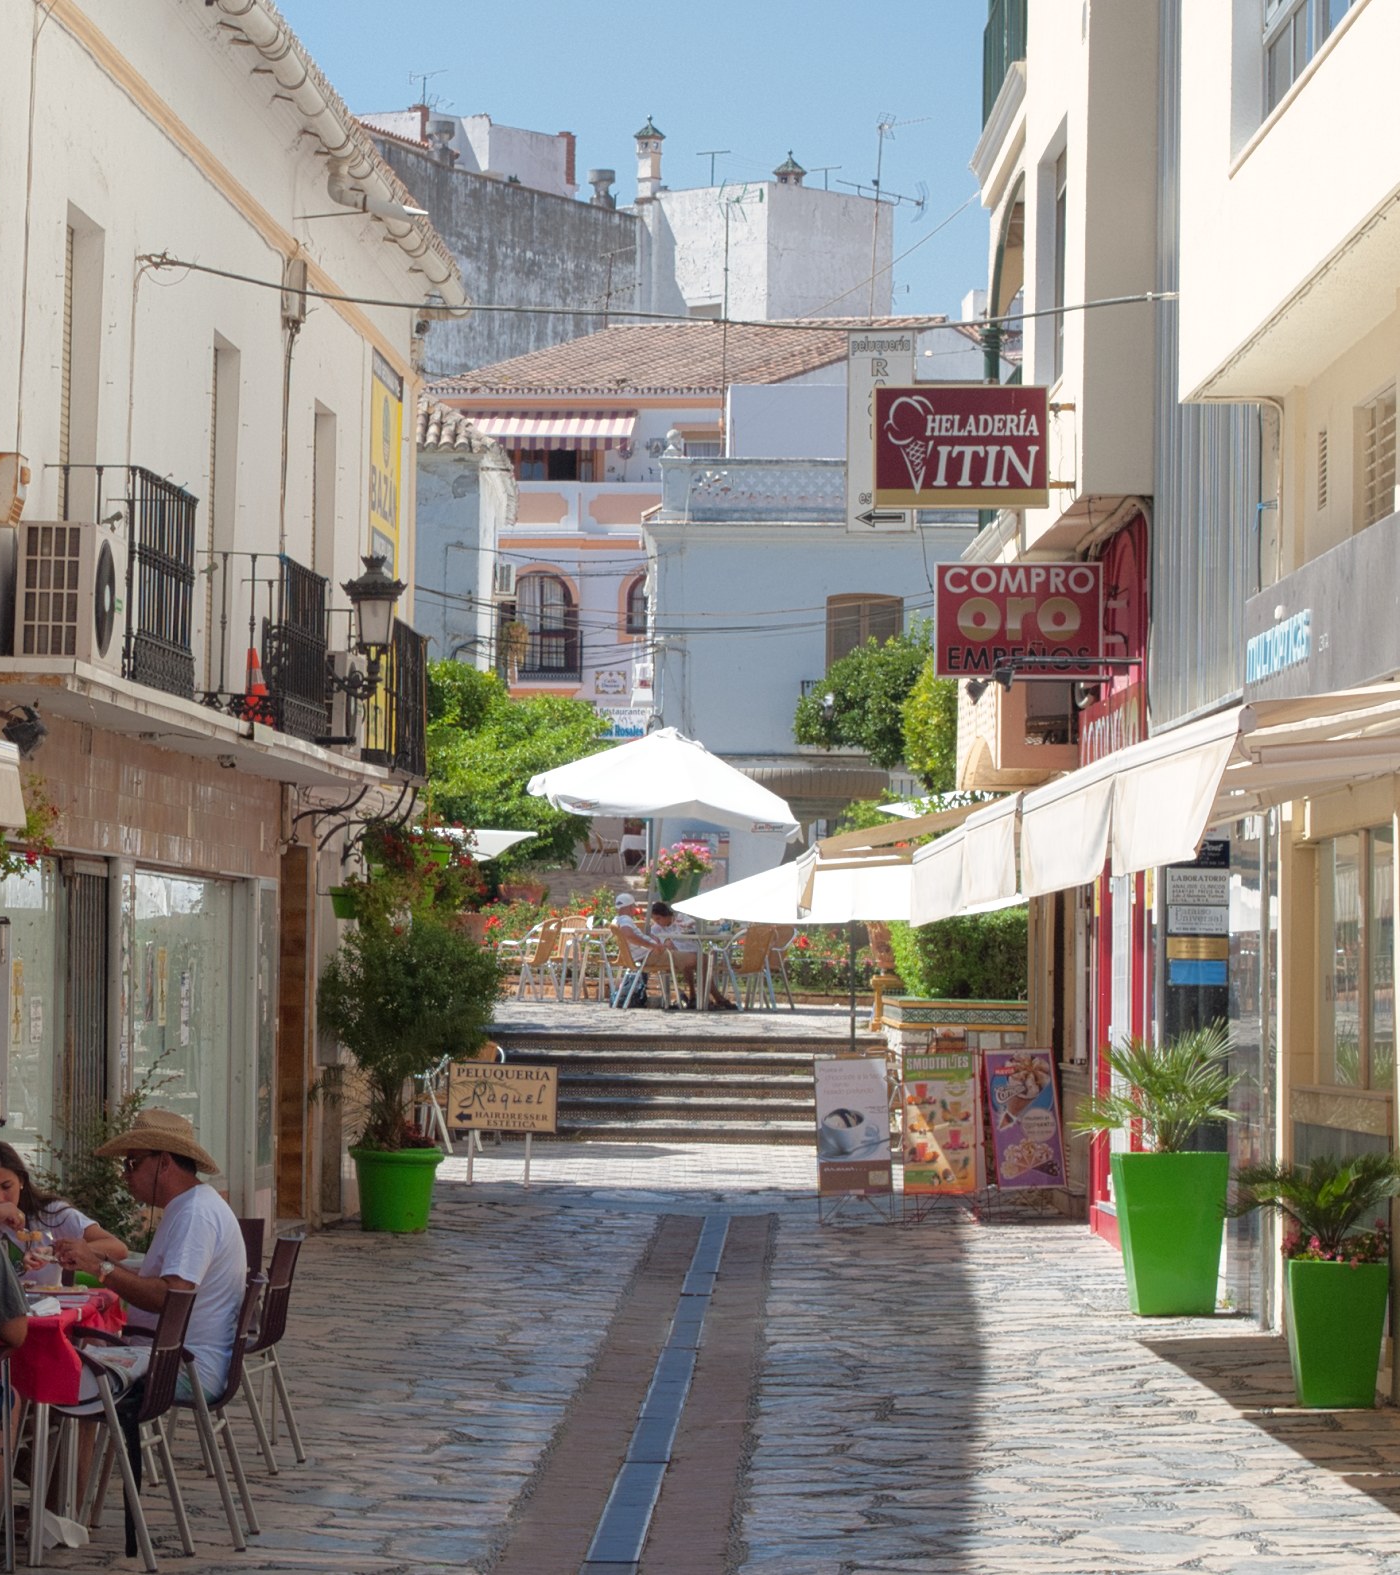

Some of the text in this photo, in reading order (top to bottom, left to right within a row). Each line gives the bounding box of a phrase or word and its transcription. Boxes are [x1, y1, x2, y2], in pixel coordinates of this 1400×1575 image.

[851, 337, 911, 357] peluquería
[925, 409, 1040, 437] HELADERÍA
[944, 567, 1095, 593] COMPRO
[957, 596, 1082, 642] oro
[948, 641, 1092, 672] EMPEÑOS
[1171, 875, 1227, 883] LABORATORIO
[456, 1067, 551, 1082] PELUQUERÍA
[458, 1080, 547, 1111] Raquel
[475, 1111, 550, 1121] HAIRDRESSER
